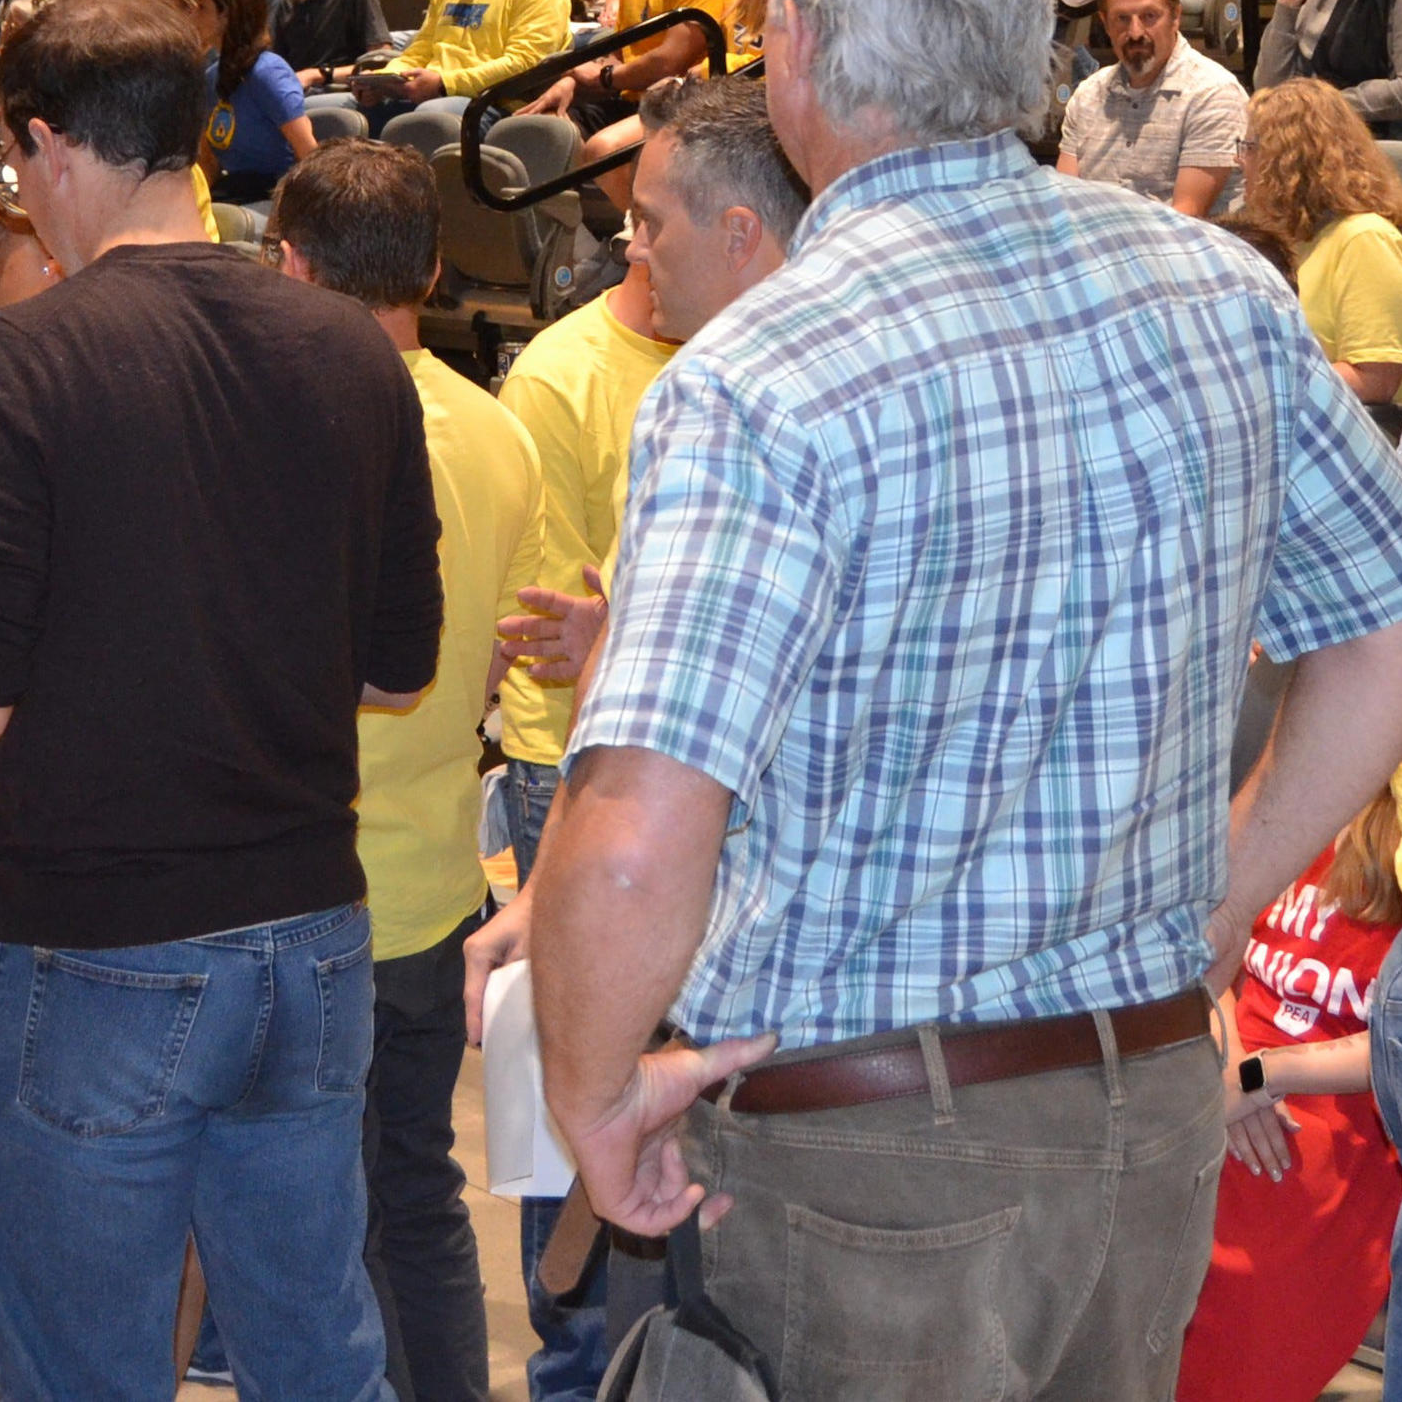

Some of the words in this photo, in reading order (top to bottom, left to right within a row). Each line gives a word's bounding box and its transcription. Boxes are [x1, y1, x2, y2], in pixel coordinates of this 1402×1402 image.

[1266, 882, 1341, 942] MY
[1243, 937, 1378, 1023] NION
[1282, 1003, 1310, 1024] PEA
